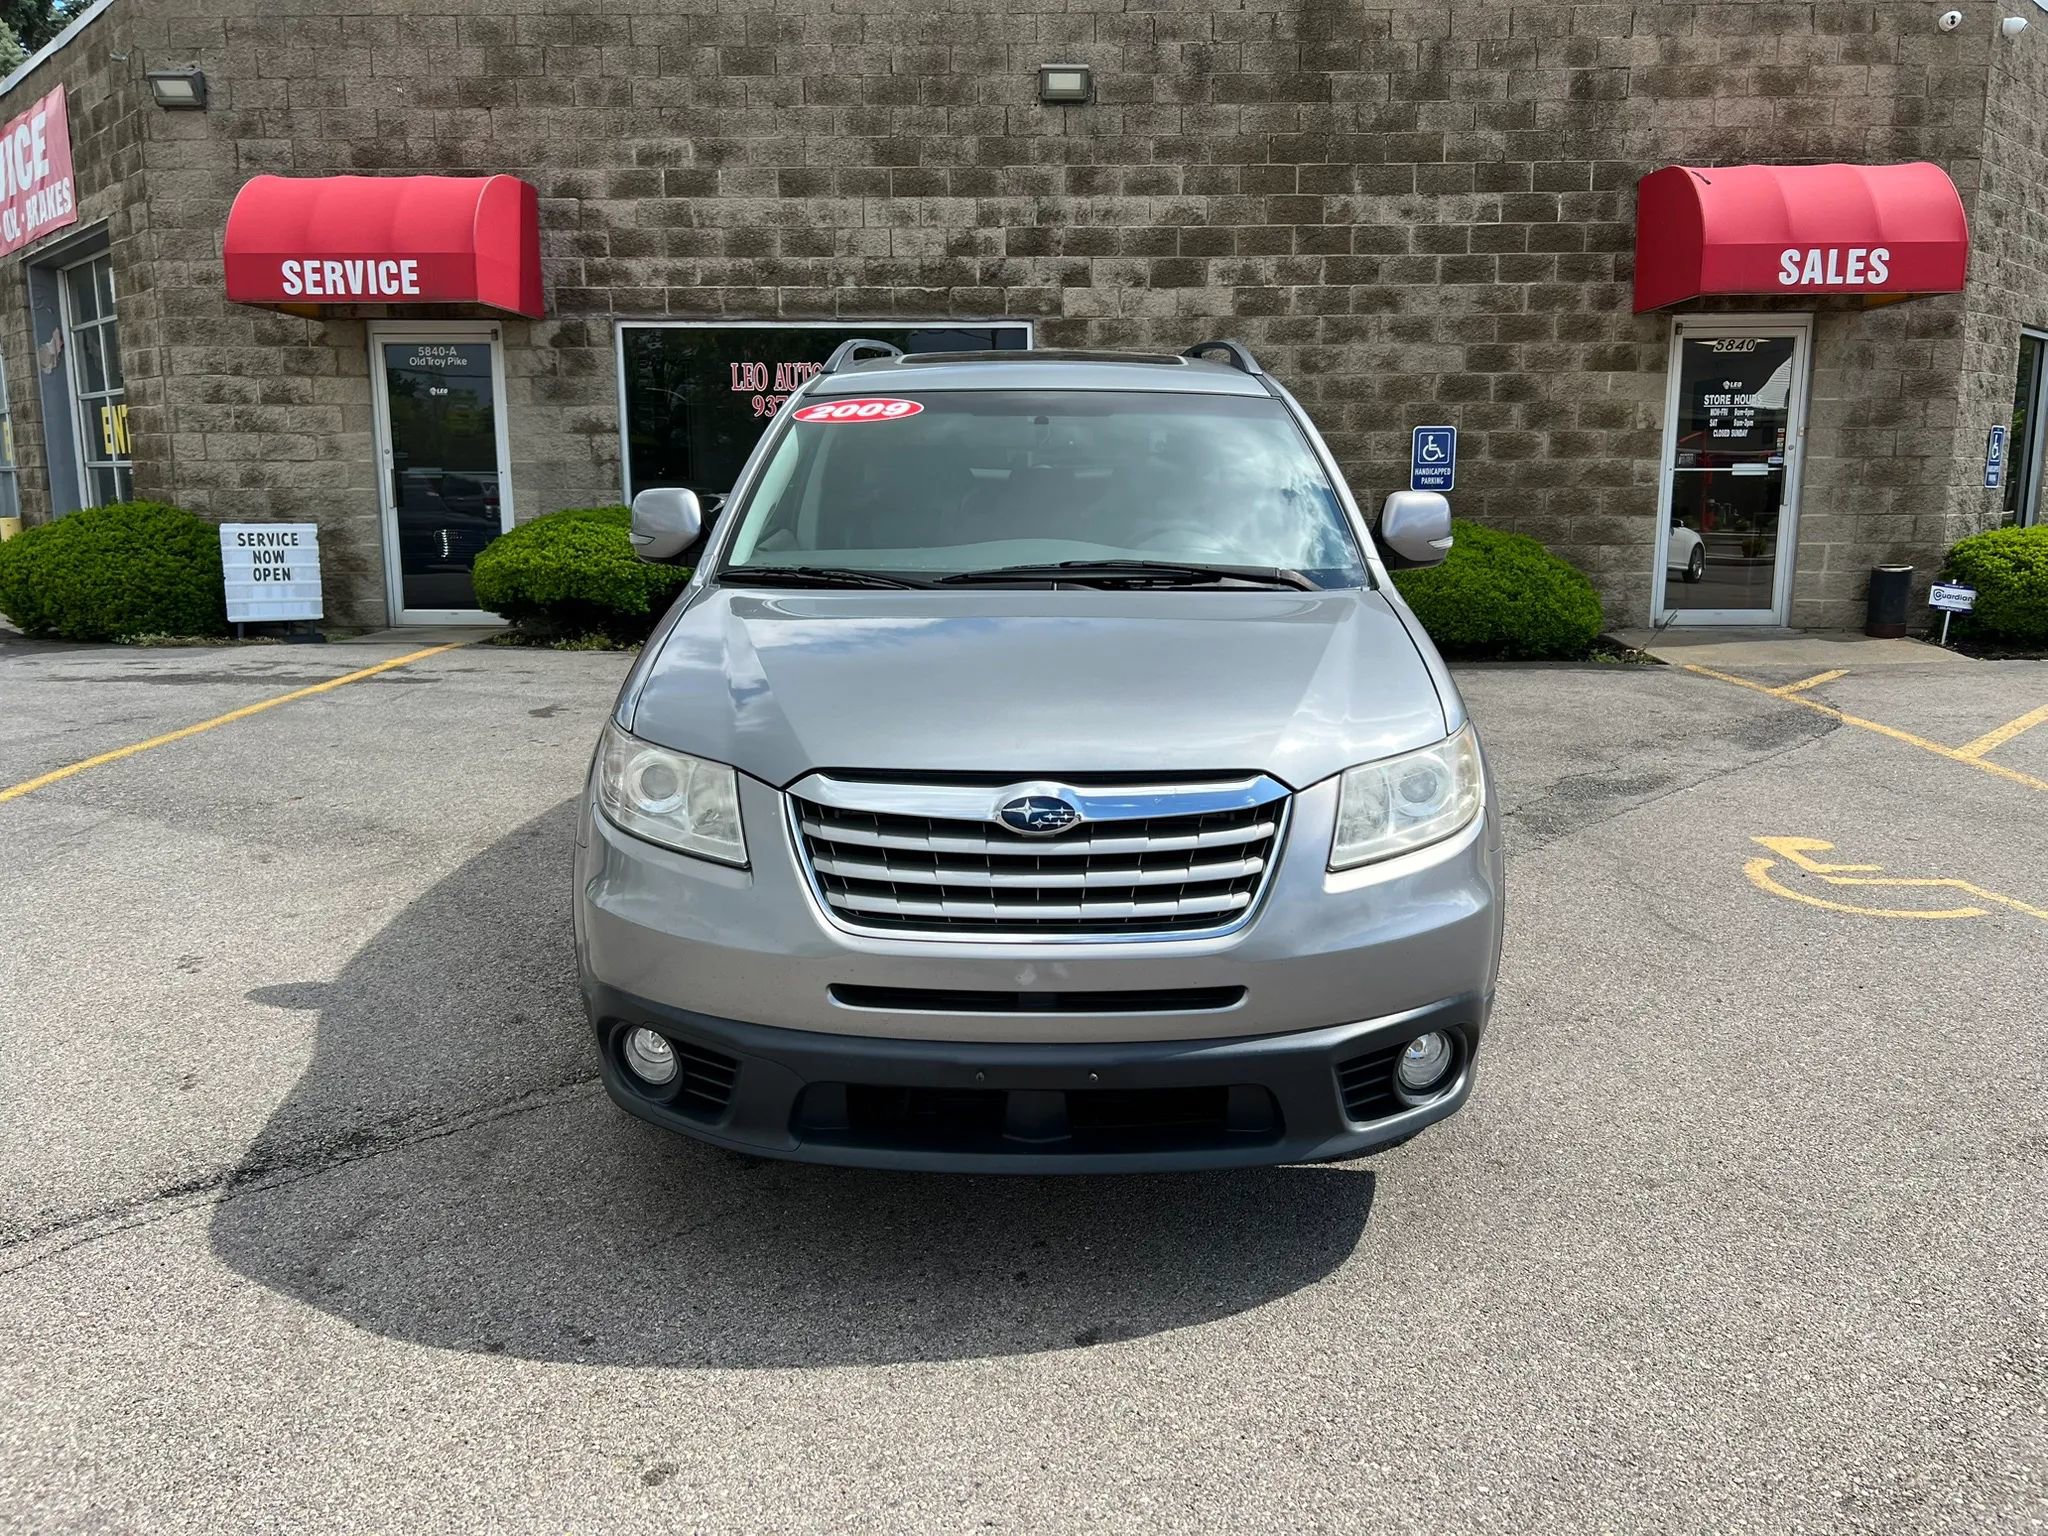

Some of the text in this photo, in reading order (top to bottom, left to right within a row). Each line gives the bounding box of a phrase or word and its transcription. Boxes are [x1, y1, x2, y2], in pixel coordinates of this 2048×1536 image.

[26, 177, 73, 232] BRAKES
[1778, 248, 1890, 285] SALES
[281, 259, 420, 295] SERVICE
[418, 346, 457, 356] 5840-A
[1715, 339, 1756, 351] 5840
[409, 357, 468, 368] Old Troy Pike
[730, 362, 769, 391] LEO
[1703, 394, 1731, 405] STORE
[803, 402, 911, 420] 2009
[1415, 467, 1451, 476] HANDICAPPED
[1421, 476, 1444, 485] PARKING
[237, 532, 299, 547] SERVICE
[252, 550, 285, 564] NOW
[253, 567, 291, 582] OPEN
[1933, 589, 1973, 602] Guardian
